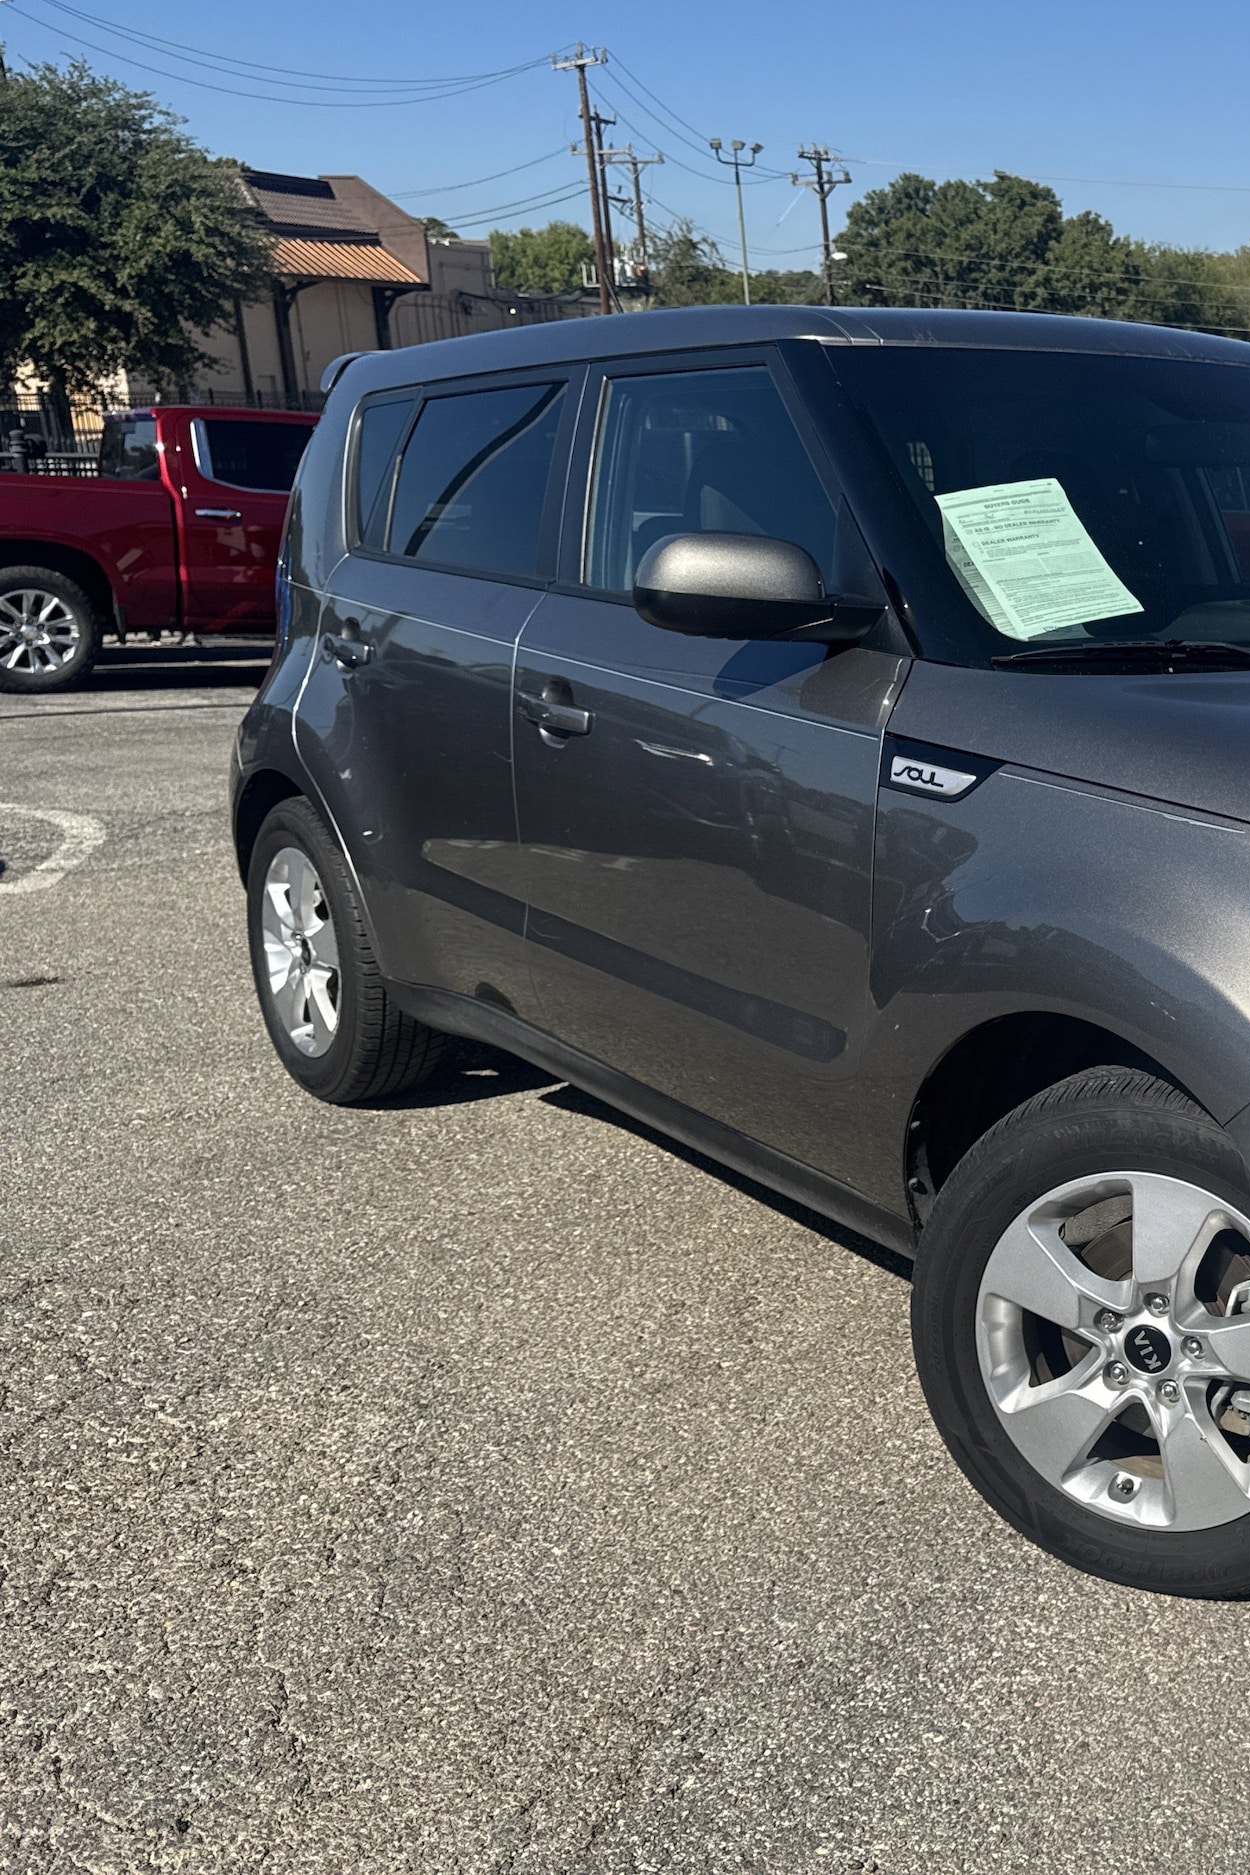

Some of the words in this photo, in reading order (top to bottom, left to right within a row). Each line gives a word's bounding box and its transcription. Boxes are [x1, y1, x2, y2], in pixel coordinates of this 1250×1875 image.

[984, 501, 1010, 509] BUYERS
[1011, 498, 1031, 506] GUIDE
[1004, 521, 1028, 529] DEALER
[1028, 518, 1061, 526] WARRANTY
[981, 538, 1006, 546] DEALER
[1007, 534, 1040, 542] WARRANTY
[893, 765, 944, 788] SOUL
[1133, 1330, 1162, 1370] KIA
